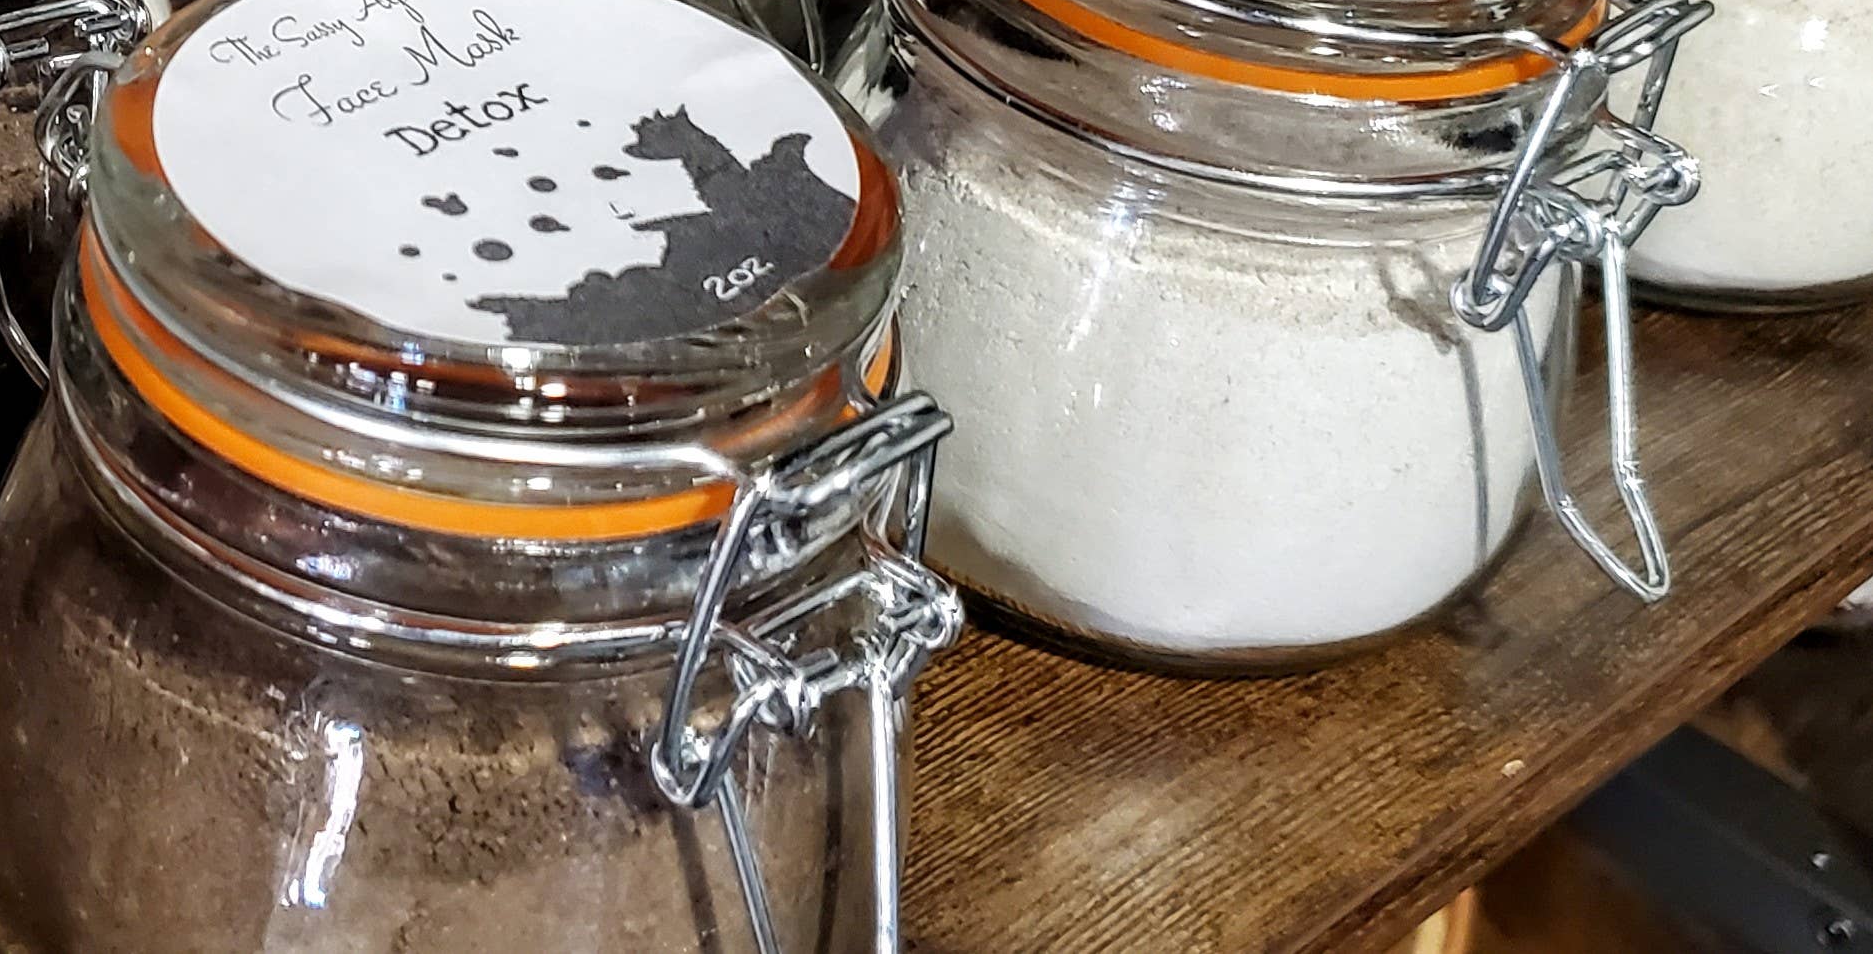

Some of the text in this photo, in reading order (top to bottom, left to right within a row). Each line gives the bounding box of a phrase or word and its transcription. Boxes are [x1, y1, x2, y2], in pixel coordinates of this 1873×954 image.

[209, 34, 282, 67] The
[271, 15, 366, 48] Sassy
[271, 9, 522, 128] Face Mask
[383, 81, 550, 158] Detox
[701, 255, 776, 302] 2oz
